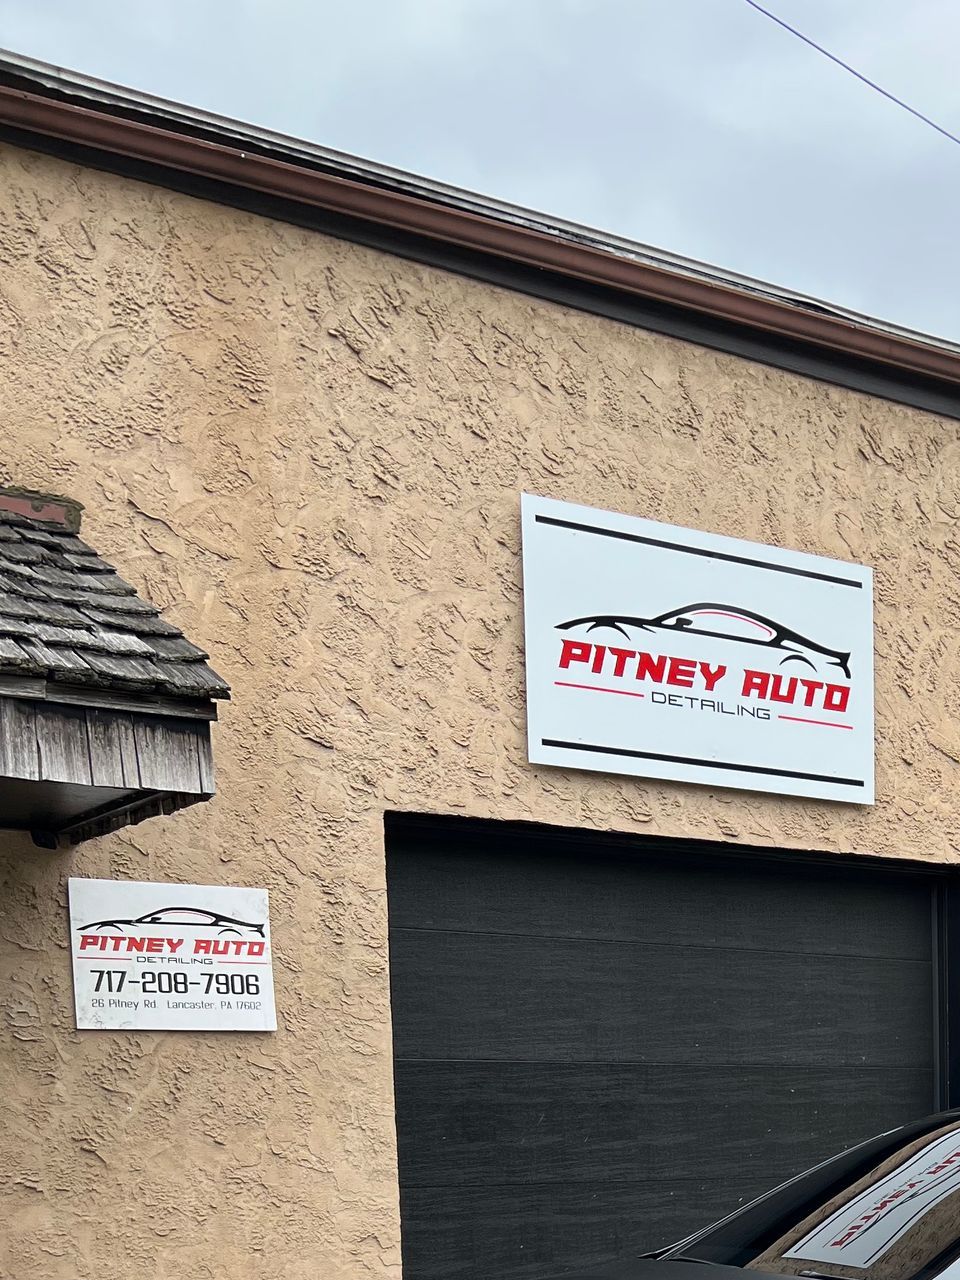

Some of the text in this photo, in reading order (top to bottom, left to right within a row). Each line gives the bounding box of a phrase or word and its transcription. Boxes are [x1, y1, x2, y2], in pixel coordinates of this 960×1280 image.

[558, 638, 851, 712] PITNEY AUTO
[651, 691, 771, 720] DETAILING
[79, 934, 266, 956] PITNEY AUTO
[136, 956, 214, 965] DETAILING
[89, 969, 261, 995] 717-208-7906
[91, 999, 104, 1008] 26
[108, 999, 139, 1011] Pitney
[220, 1001, 232, 1010] PA
[236, 1001, 262, 1010] 17602
